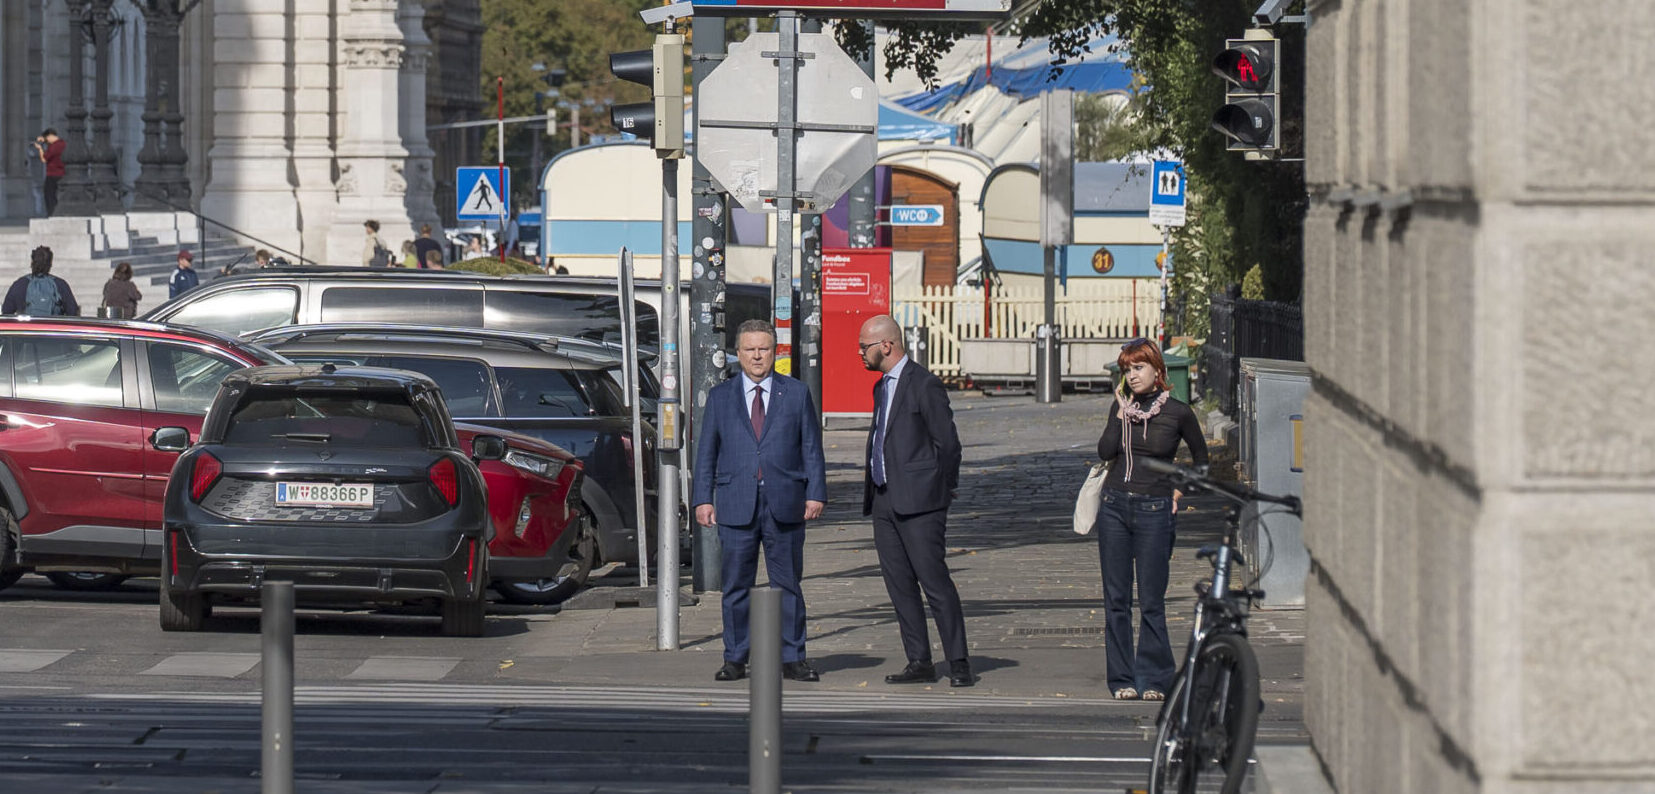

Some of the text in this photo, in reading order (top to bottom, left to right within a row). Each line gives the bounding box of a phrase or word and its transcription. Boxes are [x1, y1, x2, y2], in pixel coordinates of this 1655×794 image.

[624, 118, 634, 127] 16
[898, 209, 917, 222] WC
[822, 254, 851, 262] Fundbox
[1094, 253, 1110, 269] 31
[288, 485, 369, 502] W 88366 P
